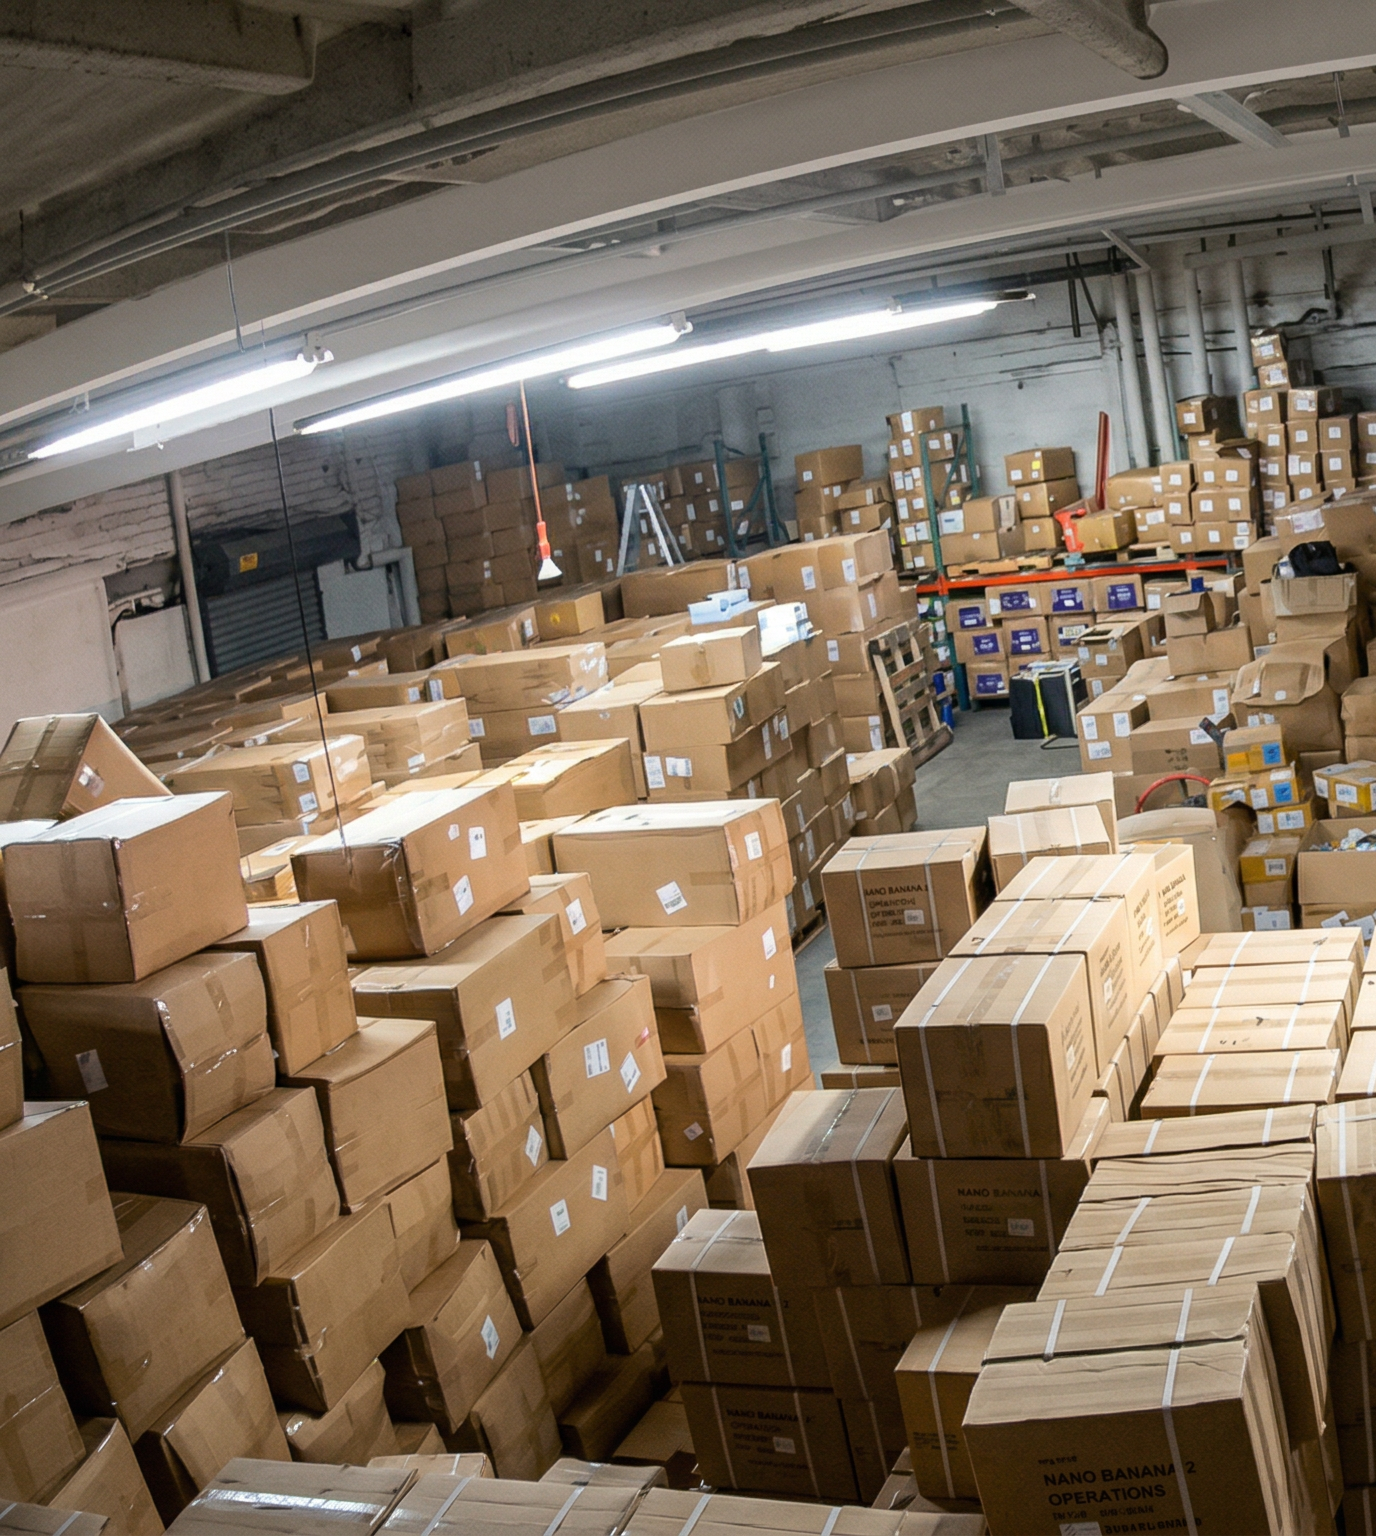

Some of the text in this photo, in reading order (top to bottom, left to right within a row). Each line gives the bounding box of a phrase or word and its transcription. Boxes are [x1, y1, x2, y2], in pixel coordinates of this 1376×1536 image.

[1043, 1461, 1197, 1487] NANO BANANA 2
[1048, 1484, 1167, 1508] OPERATIONS
